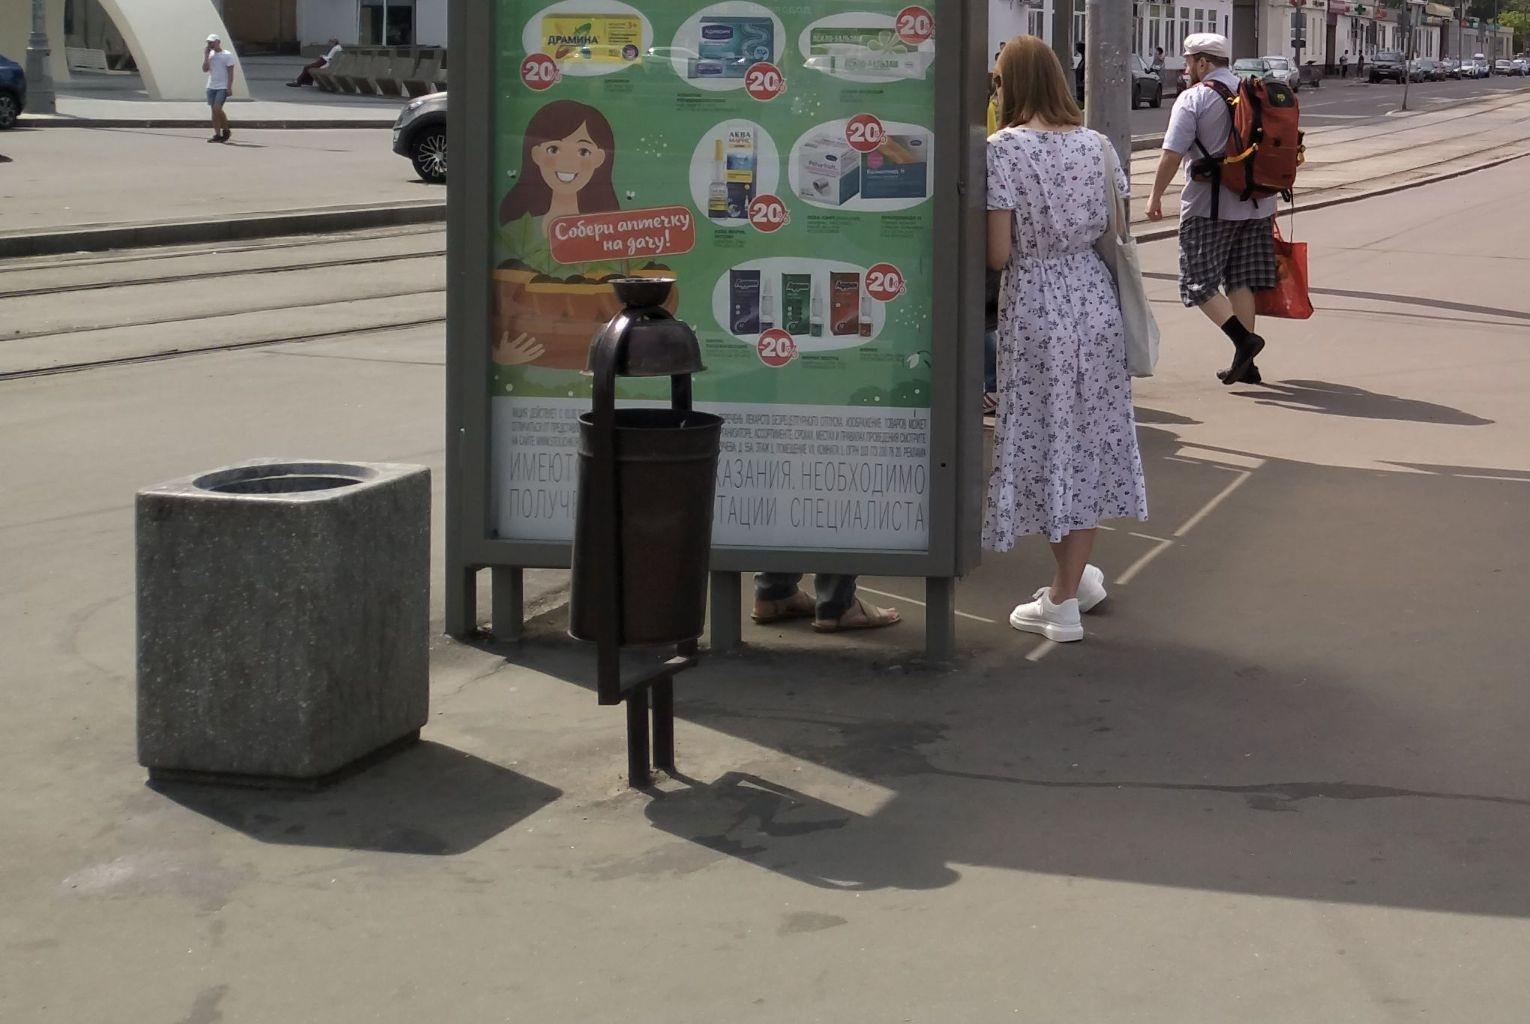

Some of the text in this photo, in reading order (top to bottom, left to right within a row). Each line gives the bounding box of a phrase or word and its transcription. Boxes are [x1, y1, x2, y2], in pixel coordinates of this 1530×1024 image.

[548, 35, 599, 45] ДРАМИНА
[523, 62, 562, 83] -20%
[748, 72, 788, 94] -20%
[847, 122, 888, 145] -20%
[751, 203, 791, 225] -20%
[555, 212, 690, 241] Собери аптечку
[603, 230, 671, 255] на дачу!
[866, 271, 906, 295] -20%
[759, 337, 799, 360] -20%
[717, 458, 926, 497] АЗАНИЯ. НЕОБХОДИМО
[716, 495, 926, 532] ТАЦИИ СПЕЦИАЛИСТА
